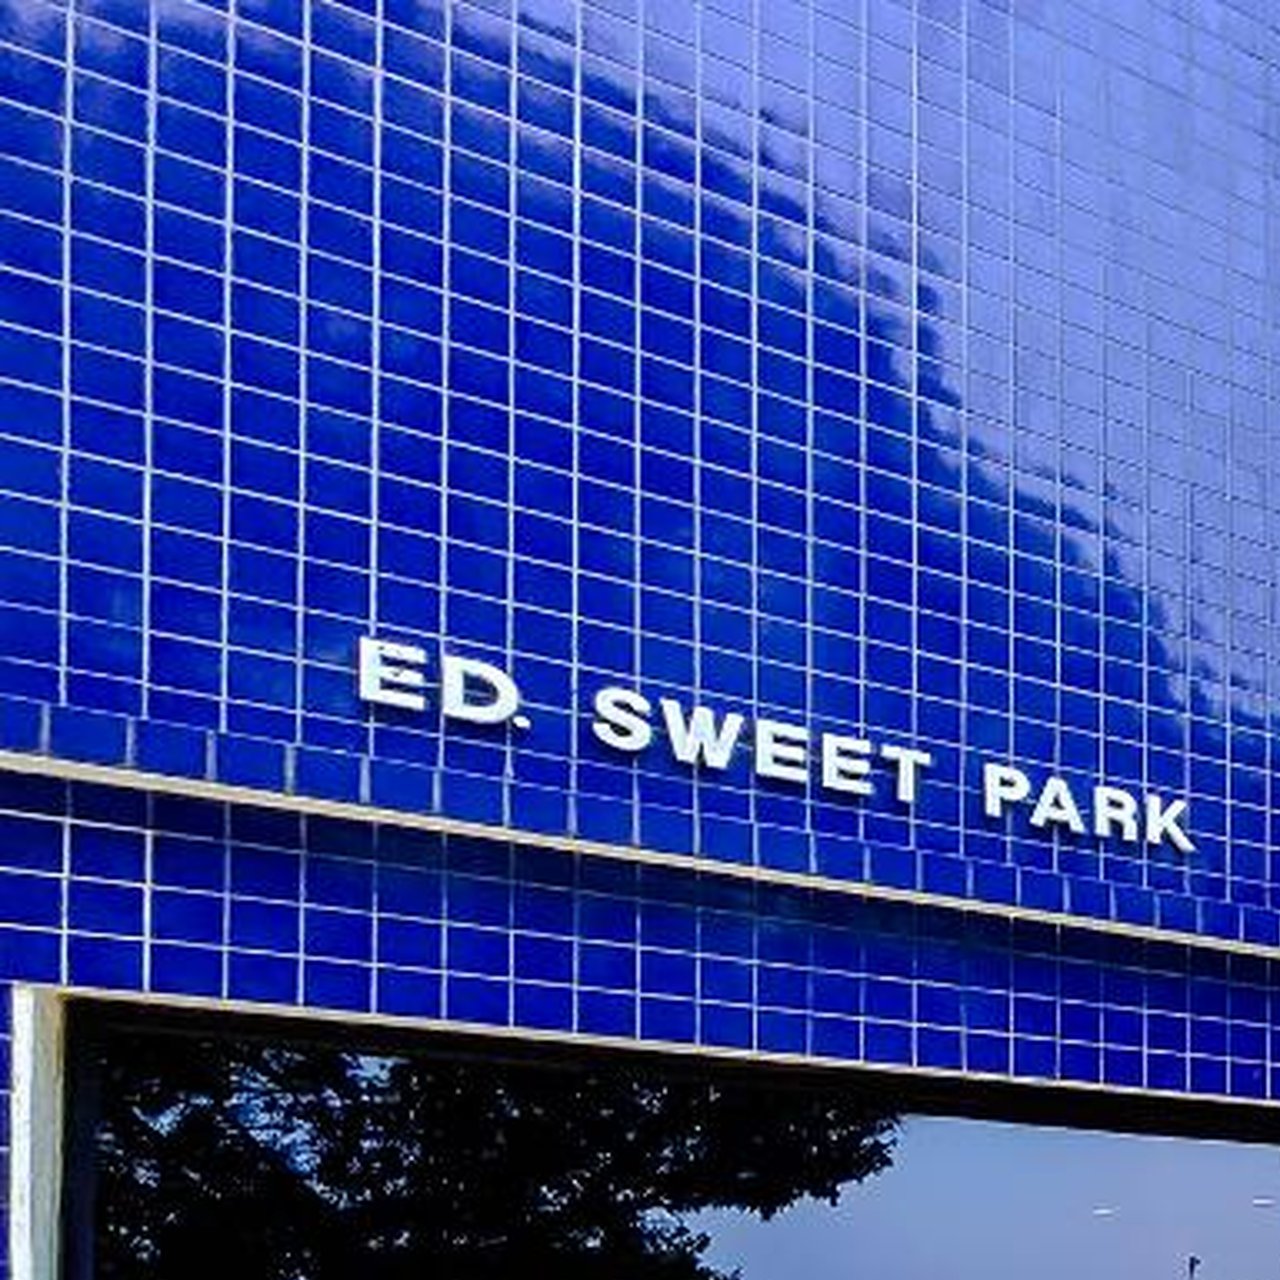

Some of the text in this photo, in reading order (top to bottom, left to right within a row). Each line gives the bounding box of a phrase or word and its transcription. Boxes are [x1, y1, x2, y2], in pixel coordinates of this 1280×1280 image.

[356, 635, 1196, 853] ED. SWEET PARK
